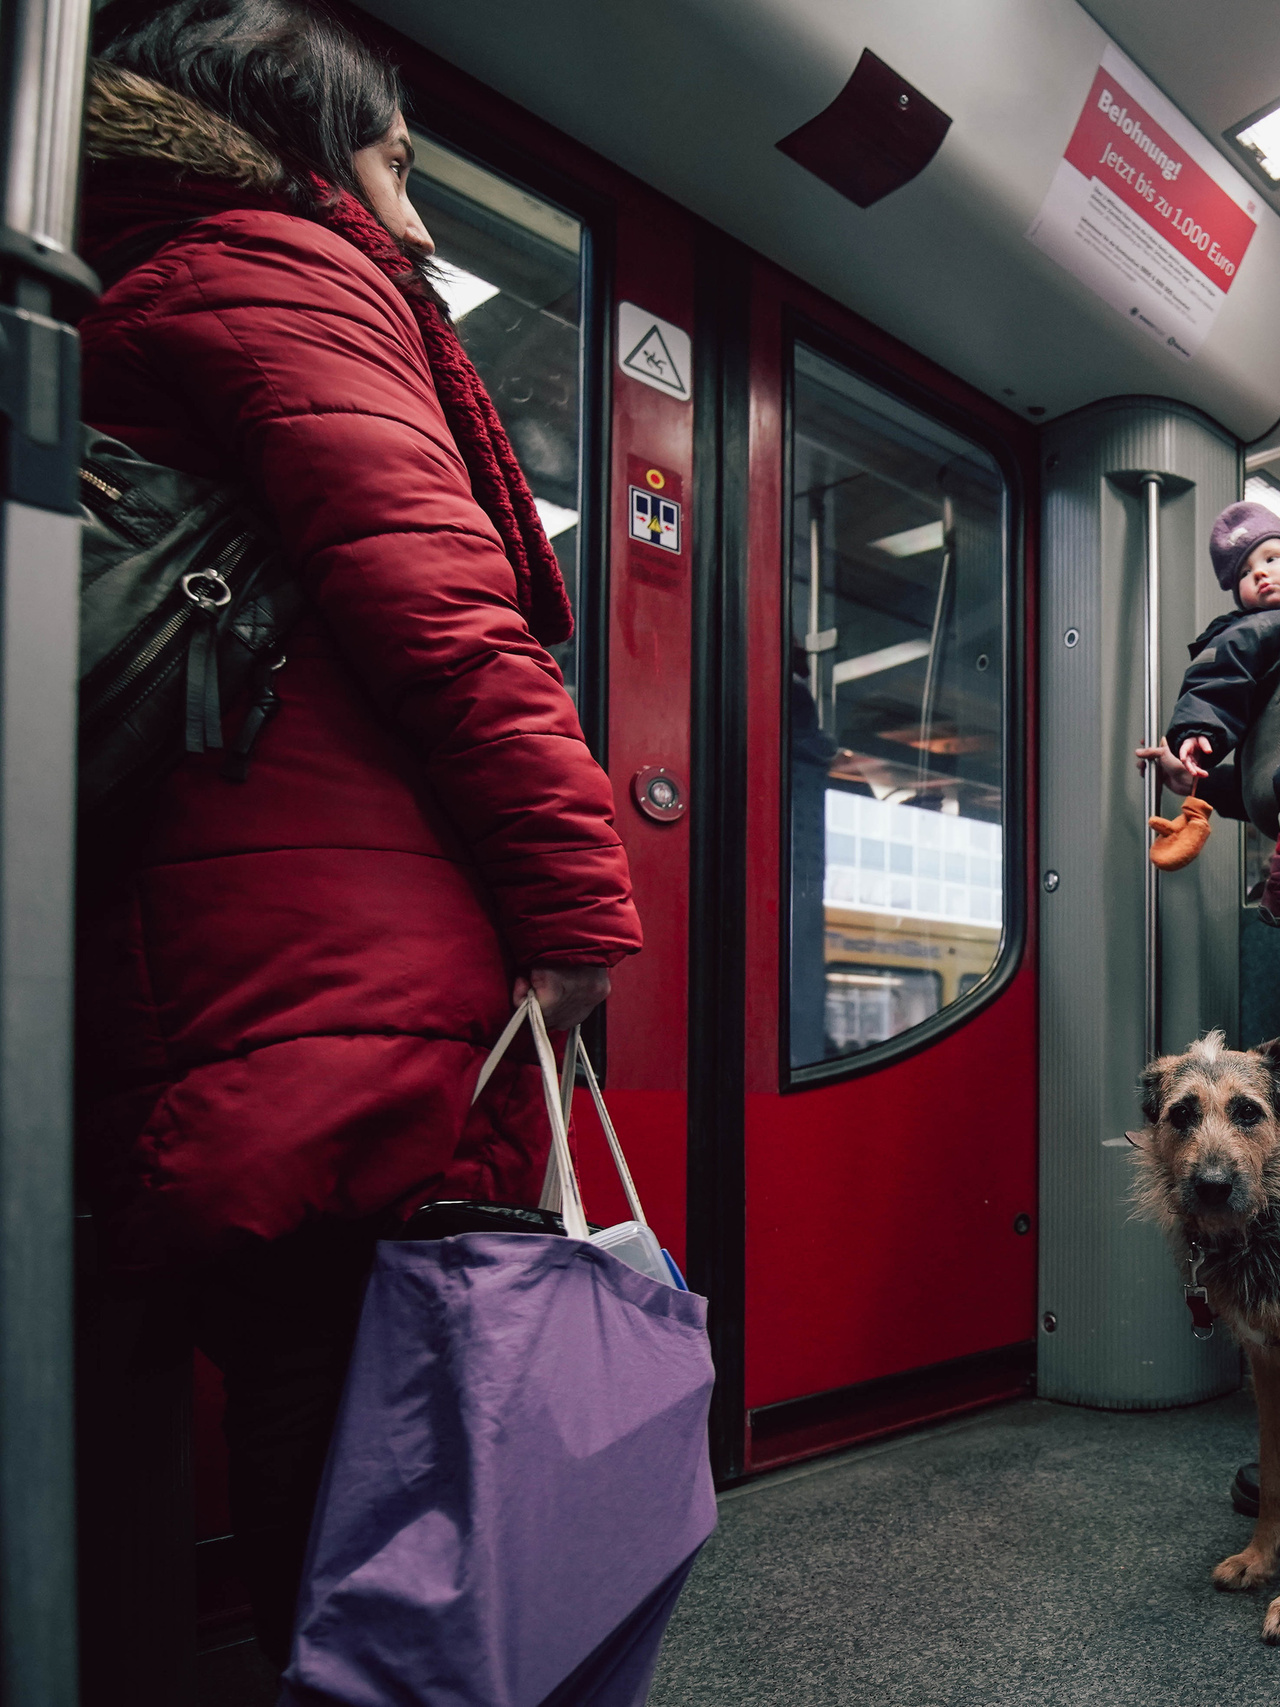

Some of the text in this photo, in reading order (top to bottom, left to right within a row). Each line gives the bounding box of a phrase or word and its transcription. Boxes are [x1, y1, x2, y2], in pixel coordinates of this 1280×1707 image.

[1097, 88, 1182, 180] Belohnung!
[1099, 142, 1236, 276] Jetzt bis zu 1.000 Euro
